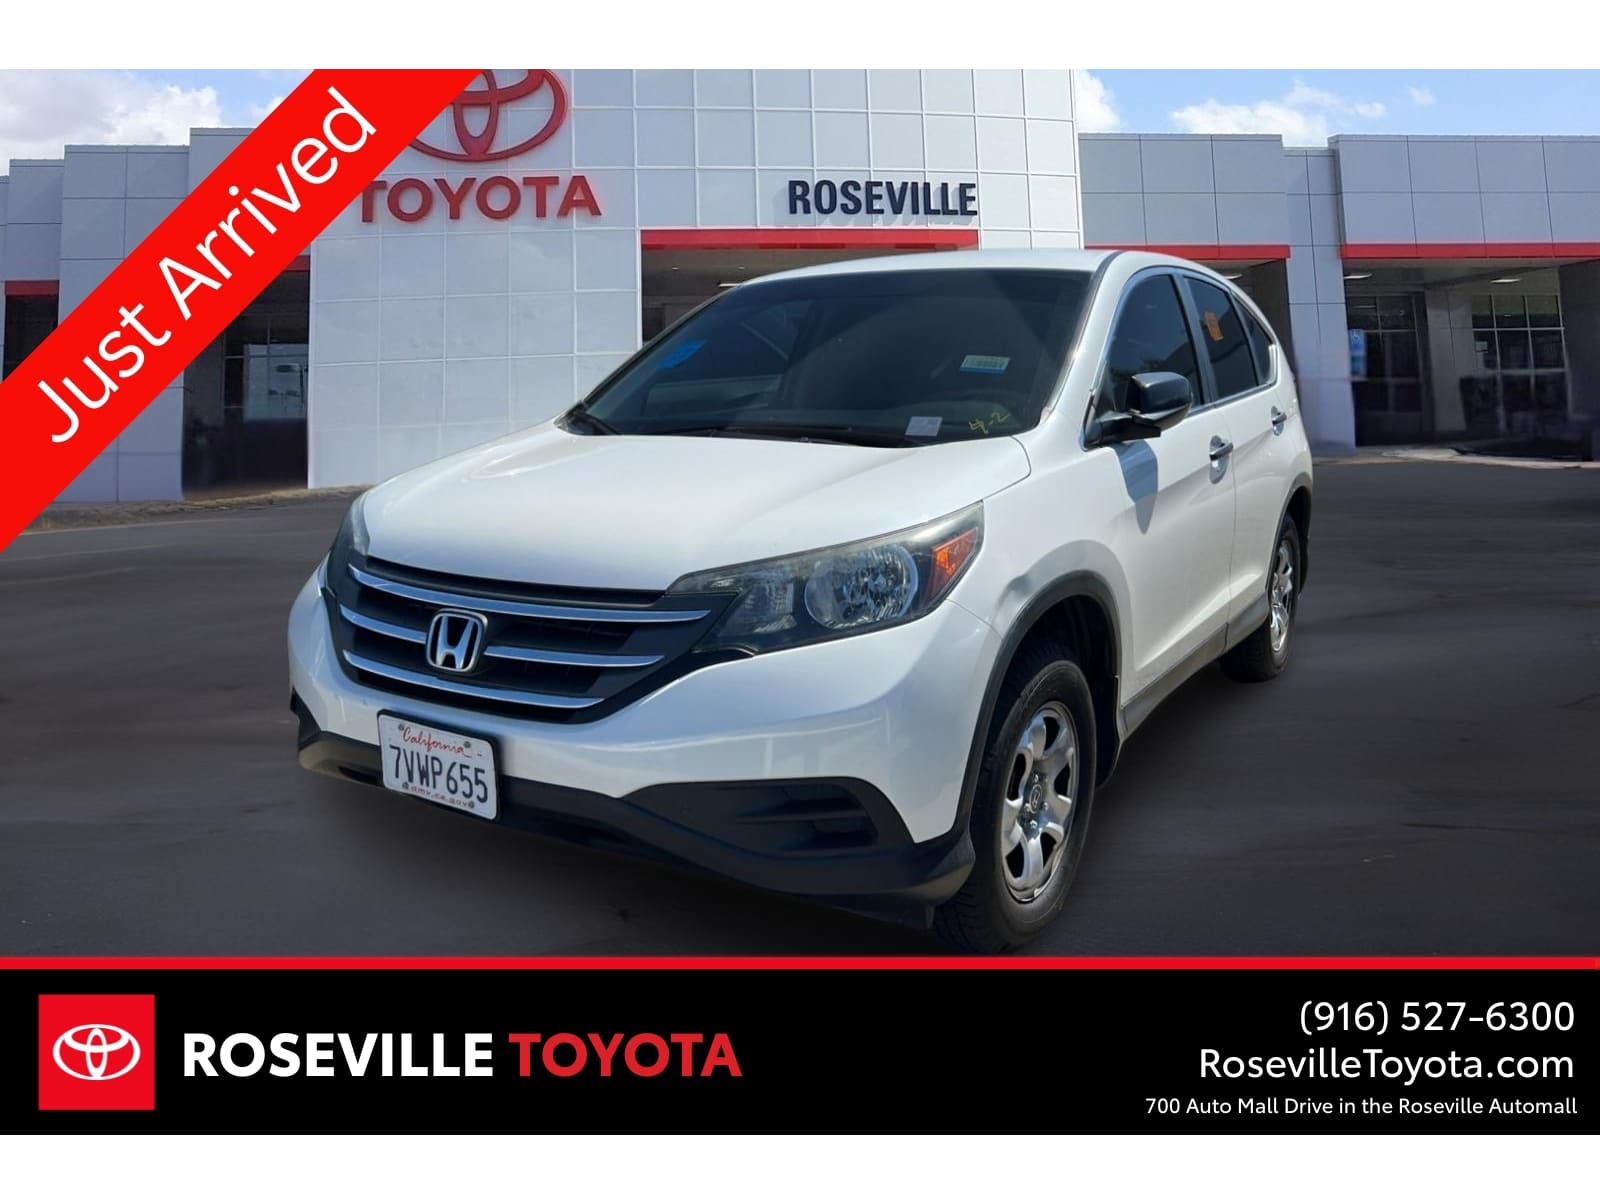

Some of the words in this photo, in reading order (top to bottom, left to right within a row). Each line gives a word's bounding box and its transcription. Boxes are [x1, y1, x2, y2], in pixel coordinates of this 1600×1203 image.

[361, 175, 601, 223] TOYOTA
[788, 180, 978, 216] ROSEVILLE
[402, 725, 472, 758] California
[389, 744, 488, 804] 7VWP655
